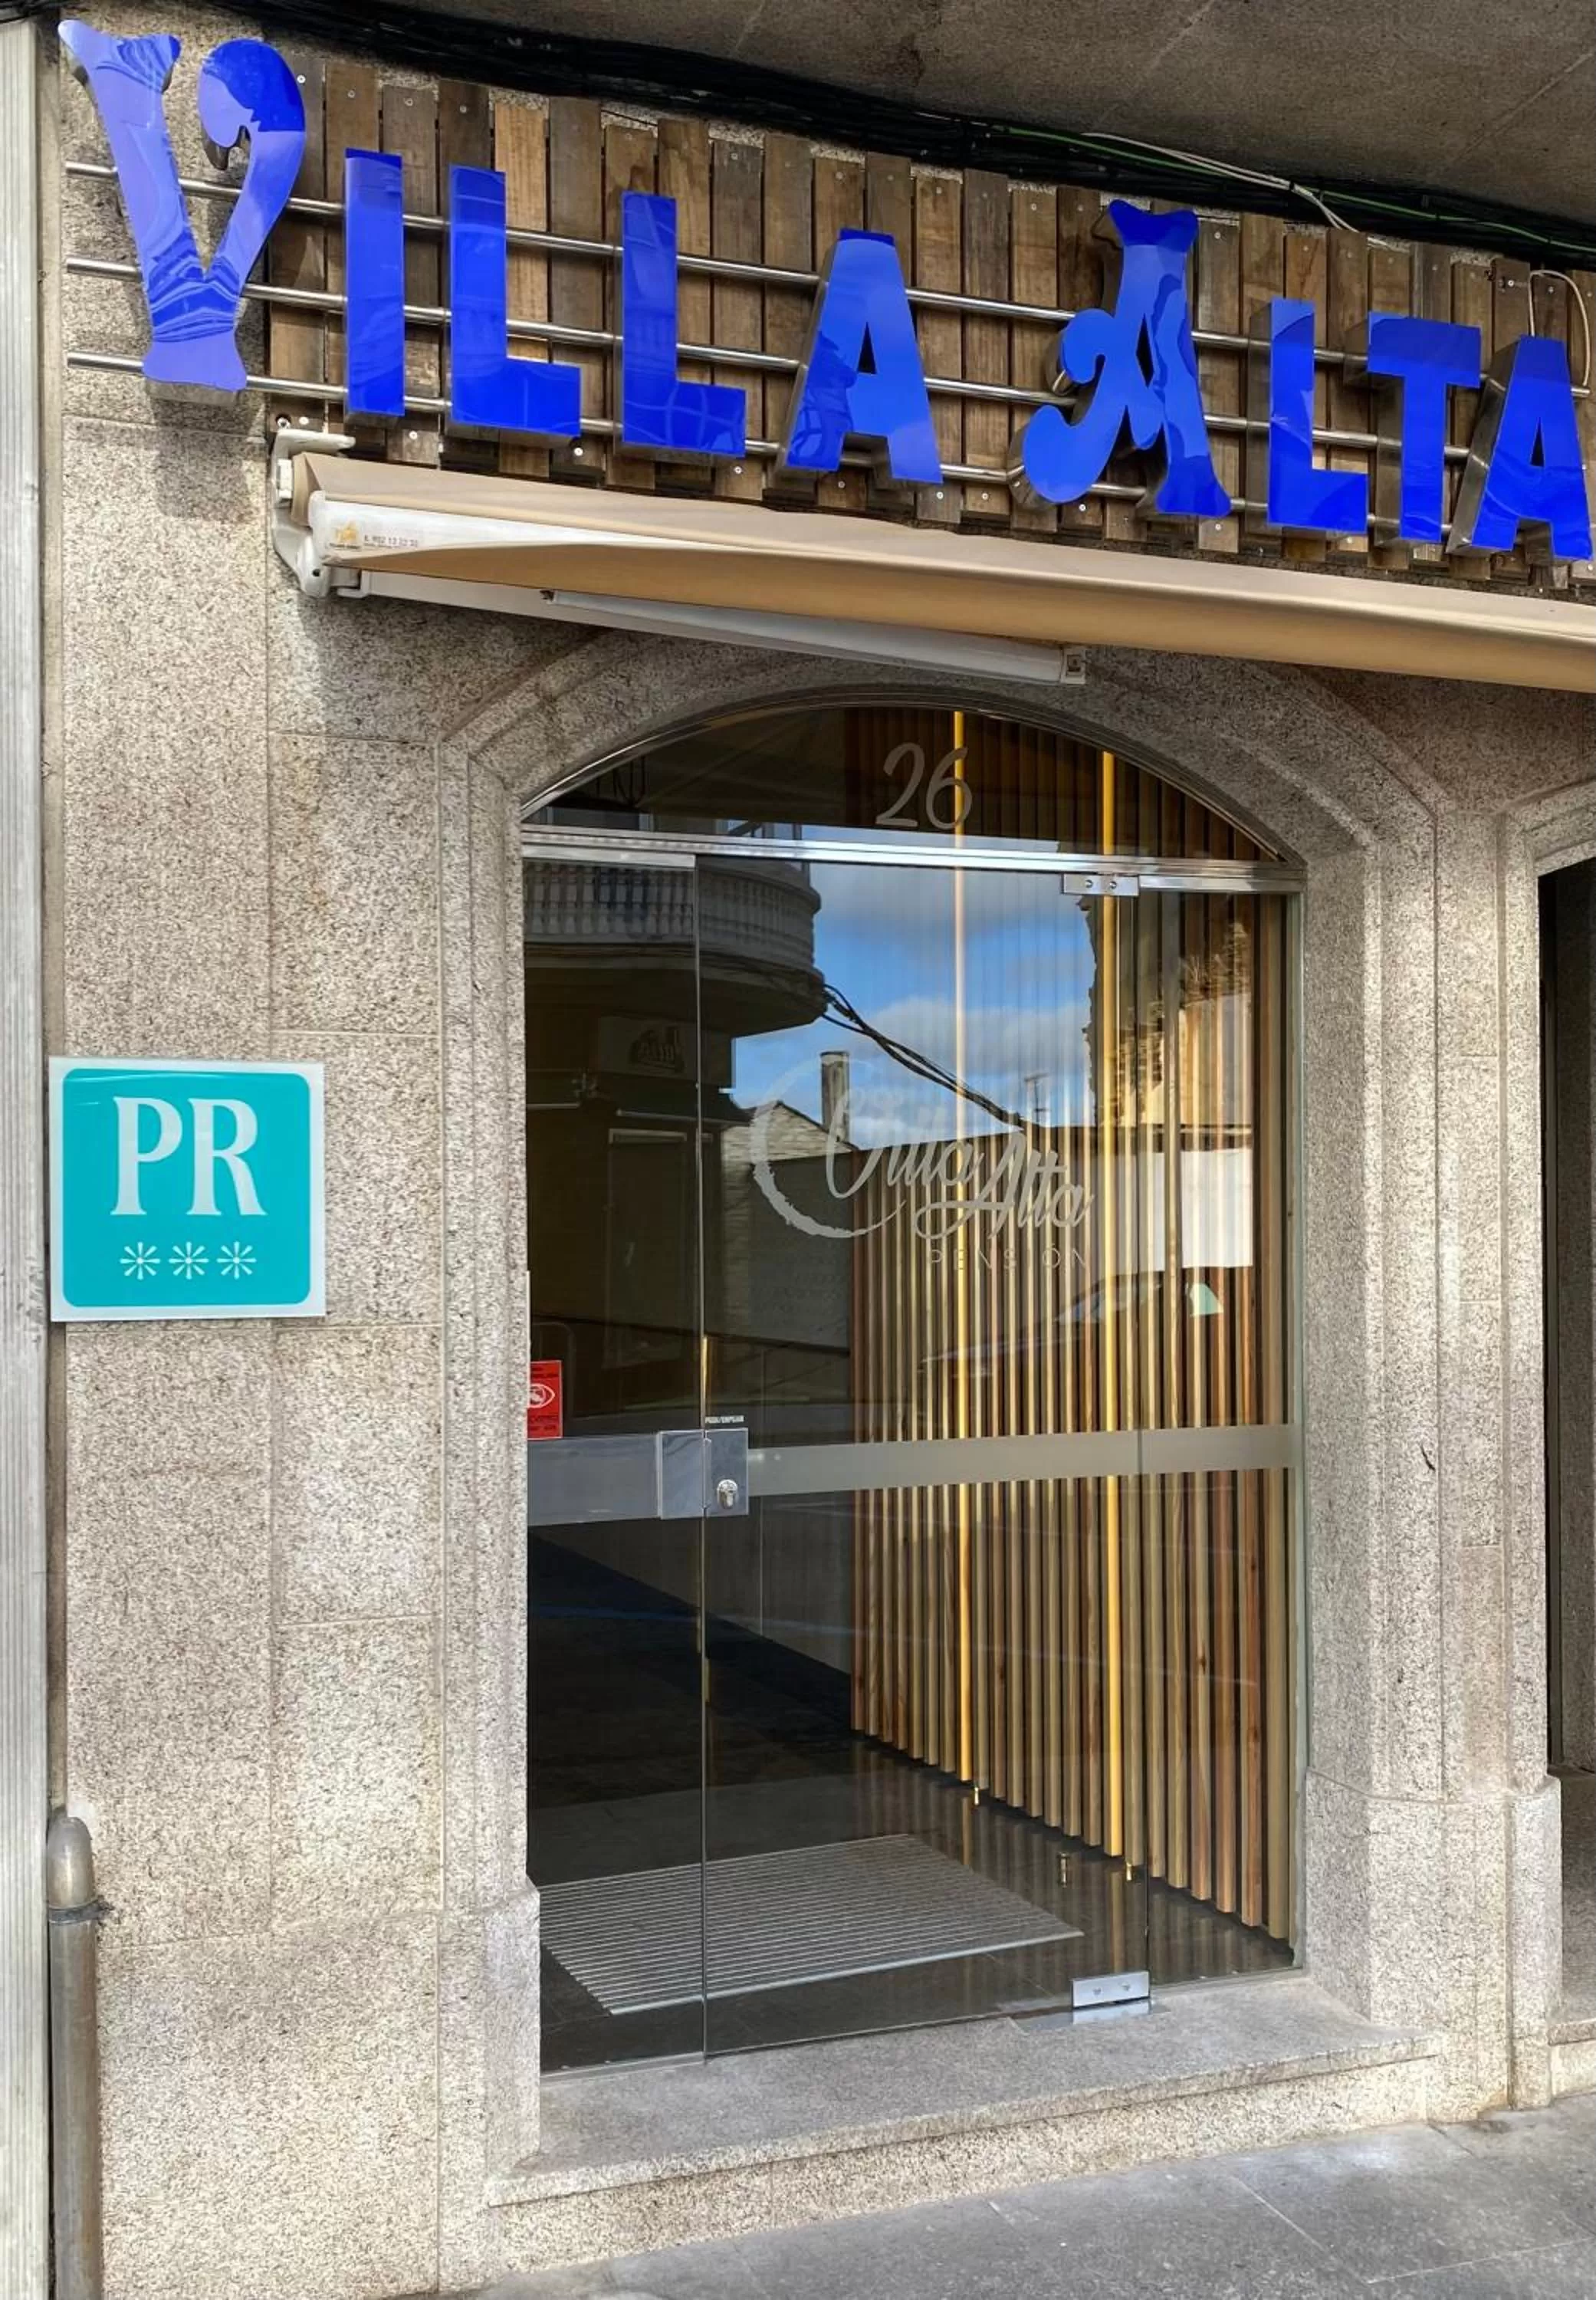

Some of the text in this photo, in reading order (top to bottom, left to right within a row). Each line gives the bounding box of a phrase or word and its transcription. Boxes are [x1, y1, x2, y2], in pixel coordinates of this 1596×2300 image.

[57, 18, 1594, 561] VILLA ALTA
[875, 742, 972, 830] 26
[110, 1096, 268, 1216] PR
[915, 1132, 1095, 1240] Alta
